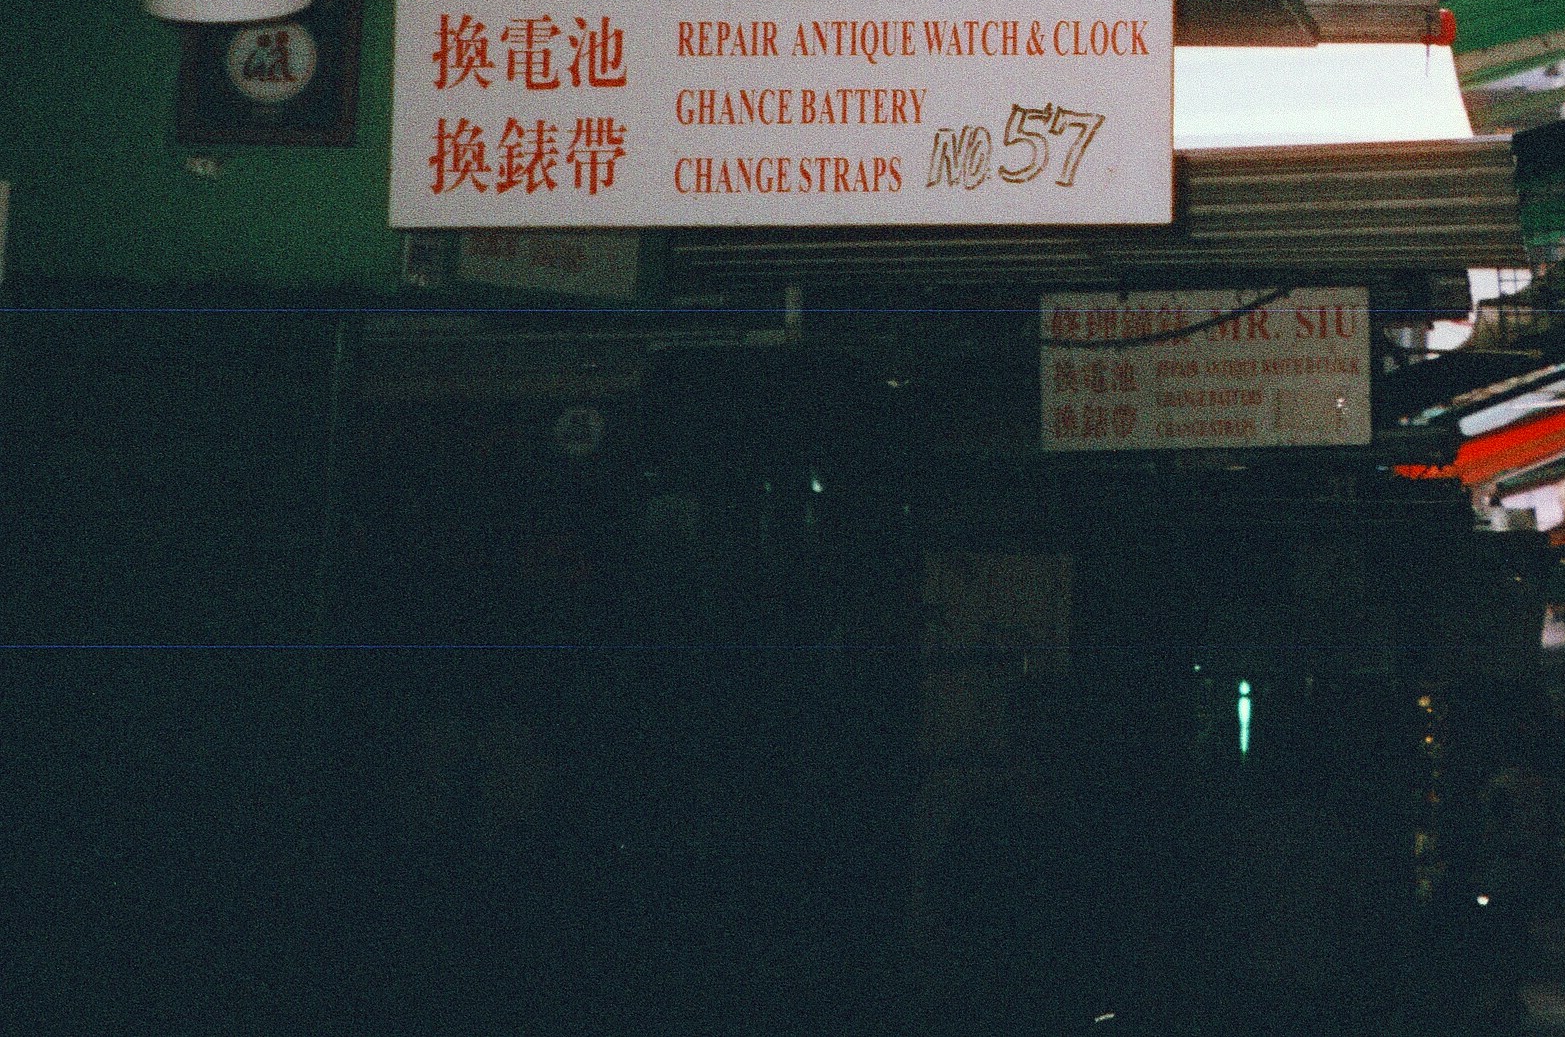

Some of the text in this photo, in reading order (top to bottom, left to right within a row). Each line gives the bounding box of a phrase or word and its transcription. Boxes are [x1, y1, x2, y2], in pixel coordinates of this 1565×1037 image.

[433, 14, 628, 91] 換電池
[677, 20, 780, 57] REPAIR
[793, 20, 916, 65] ANTIQUE
[801, 88, 927, 125] BATTERY
[429, 116, 628, 197] 換錶帶
[999, 102, 1106, 190] 57
[675, 156, 903, 194] CHANGE STRAPS
[1296, 304, 1356, 339] SIU
